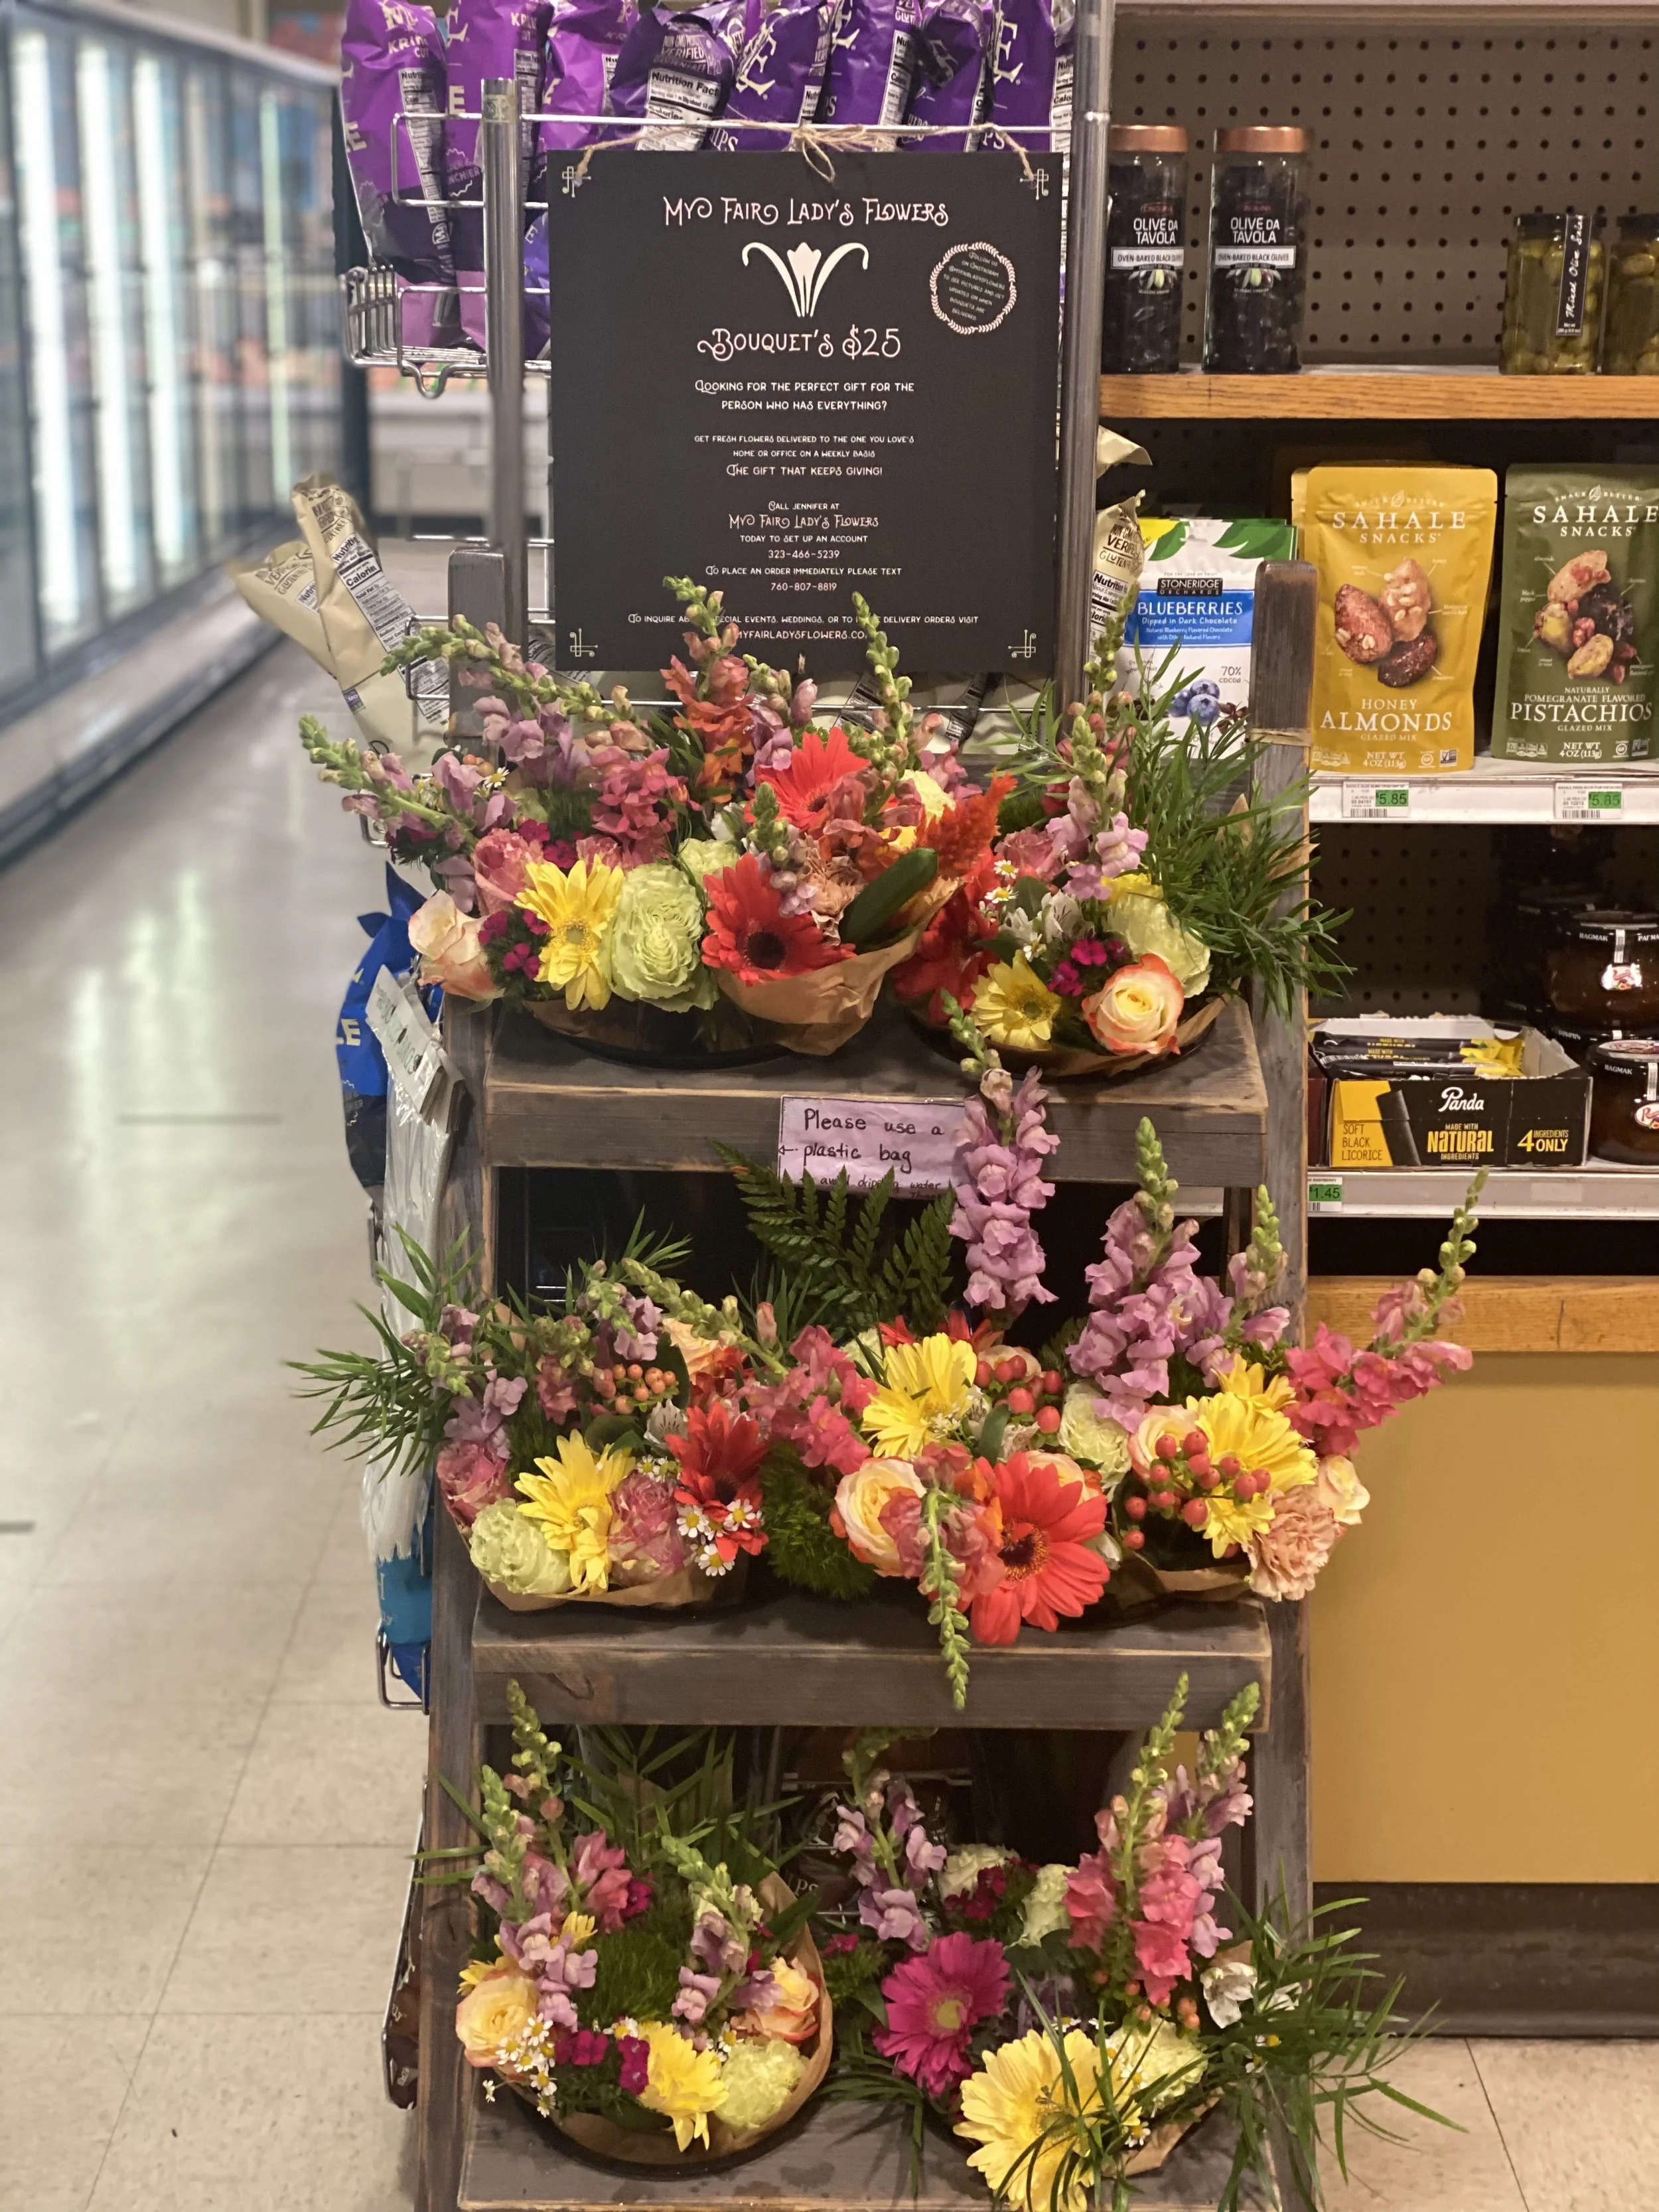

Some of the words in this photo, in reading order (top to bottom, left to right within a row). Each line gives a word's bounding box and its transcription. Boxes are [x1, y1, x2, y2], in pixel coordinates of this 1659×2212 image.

[652, 72, 693, 90] Nutrition
[662, 196, 713, 226] MY
[720, 196, 779, 226] FAIR
[786, 197, 854, 226] LADY'S
[861, 197, 949, 227] FLOWERS
[1133, 218, 1167, 231] OLIVE
[1168, 220, 1178, 231] DA
[1230, 217, 1263, 230] OLIVE
[1266, 219, 1280, 230] DA
[1136, 232, 1175, 244] TAVOLA
[1233, 230, 1277, 244] TAVOLA
[696, 328, 834, 362] BOUQUET'S
[841, 323, 901, 360] $25
[694, 379, 744, 395] LOOKING
[747, 382, 767, 392] FOR
[770, 382, 791, 392] THE
[794, 382, 839, 392] PERFECT
[843, 382, 867, 392] GIFT
[870, 382, 891, 392] FOR
[894, 382, 914, 392] THE
[721, 400, 762, 410] PERSON
[766, 400, 790, 410] WHO
[792, 400, 814, 411] HAS
[817, 400, 887, 411] EVERYTHING?
[739, 435, 774, 443] FLOWERS
[726, 463, 749, 477] THE
[753, 466, 776, 476] GIFT
[780, 466, 807, 476] THAT
[810, 466, 843, 477] KEEPS
[845, 467, 883, 476] GIVING!
[768, 500, 790, 512] CALL
[1534, 504, 1659, 524] SAHALE
[728, 513, 755, 530] MY
[758, 514, 790, 530] FAIR
[794, 514, 830, 530] LADY'S
[833, 514, 879, 528] FLOWERS
[1333, 511, 1465, 530] SAHALE
[1560, 526, 1632, 537] SNACKS
[1360, 533, 1437, 544] SNACKS
[768, 549, 840, 559] 323-466-5239
[705, 564, 719, 576] TO
[770, 582, 837, 591] 760-807-8819
[1161, 579, 1220, 588] STONERIDGE
[1137, 601, 1243, 615] BLUEBERRIES
[628, 613, 642, 624] TO
[828, 615, 839, 624] OR
[924, 615, 956, 624] ORDERS
[1142, 617, 1167, 626] Dipped
[1221, 666, 1242, 676] 70%
[1524, 694, 1598, 703] POMEGRANATE
[1362, 699, 1417, 711] HONEY
[1510, 701, 1652, 723] PISTACHIOS
[1321, 710, 1452, 731] ALMONDS
[1580, 750, 1602, 759] (113g)
[1605, 1065, 1632, 1074] RAGMAK
[1438, 1086, 1484, 1112] Panda
[804, 1108, 867, 1131] Please
[885, 1122, 917, 1135] use
[931, 1126, 945, 1136] a
[1343, 1124, 1364, 1134] SOFT
[1534, 1130, 1569, 1139] INGREDIENTS
[1342, 1137, 1370, 1147] BLACK
[1518, 1130, 1534, 1152] 4
[1535, 1139, 1568, 1152] ONLY
[804, 1142, 861, 1166] plastic
[879, 1143, 912, 1174] bag
[1342, 1149, 1383, 1160] LICORICE
[910, 1180, 941, 1190] water
